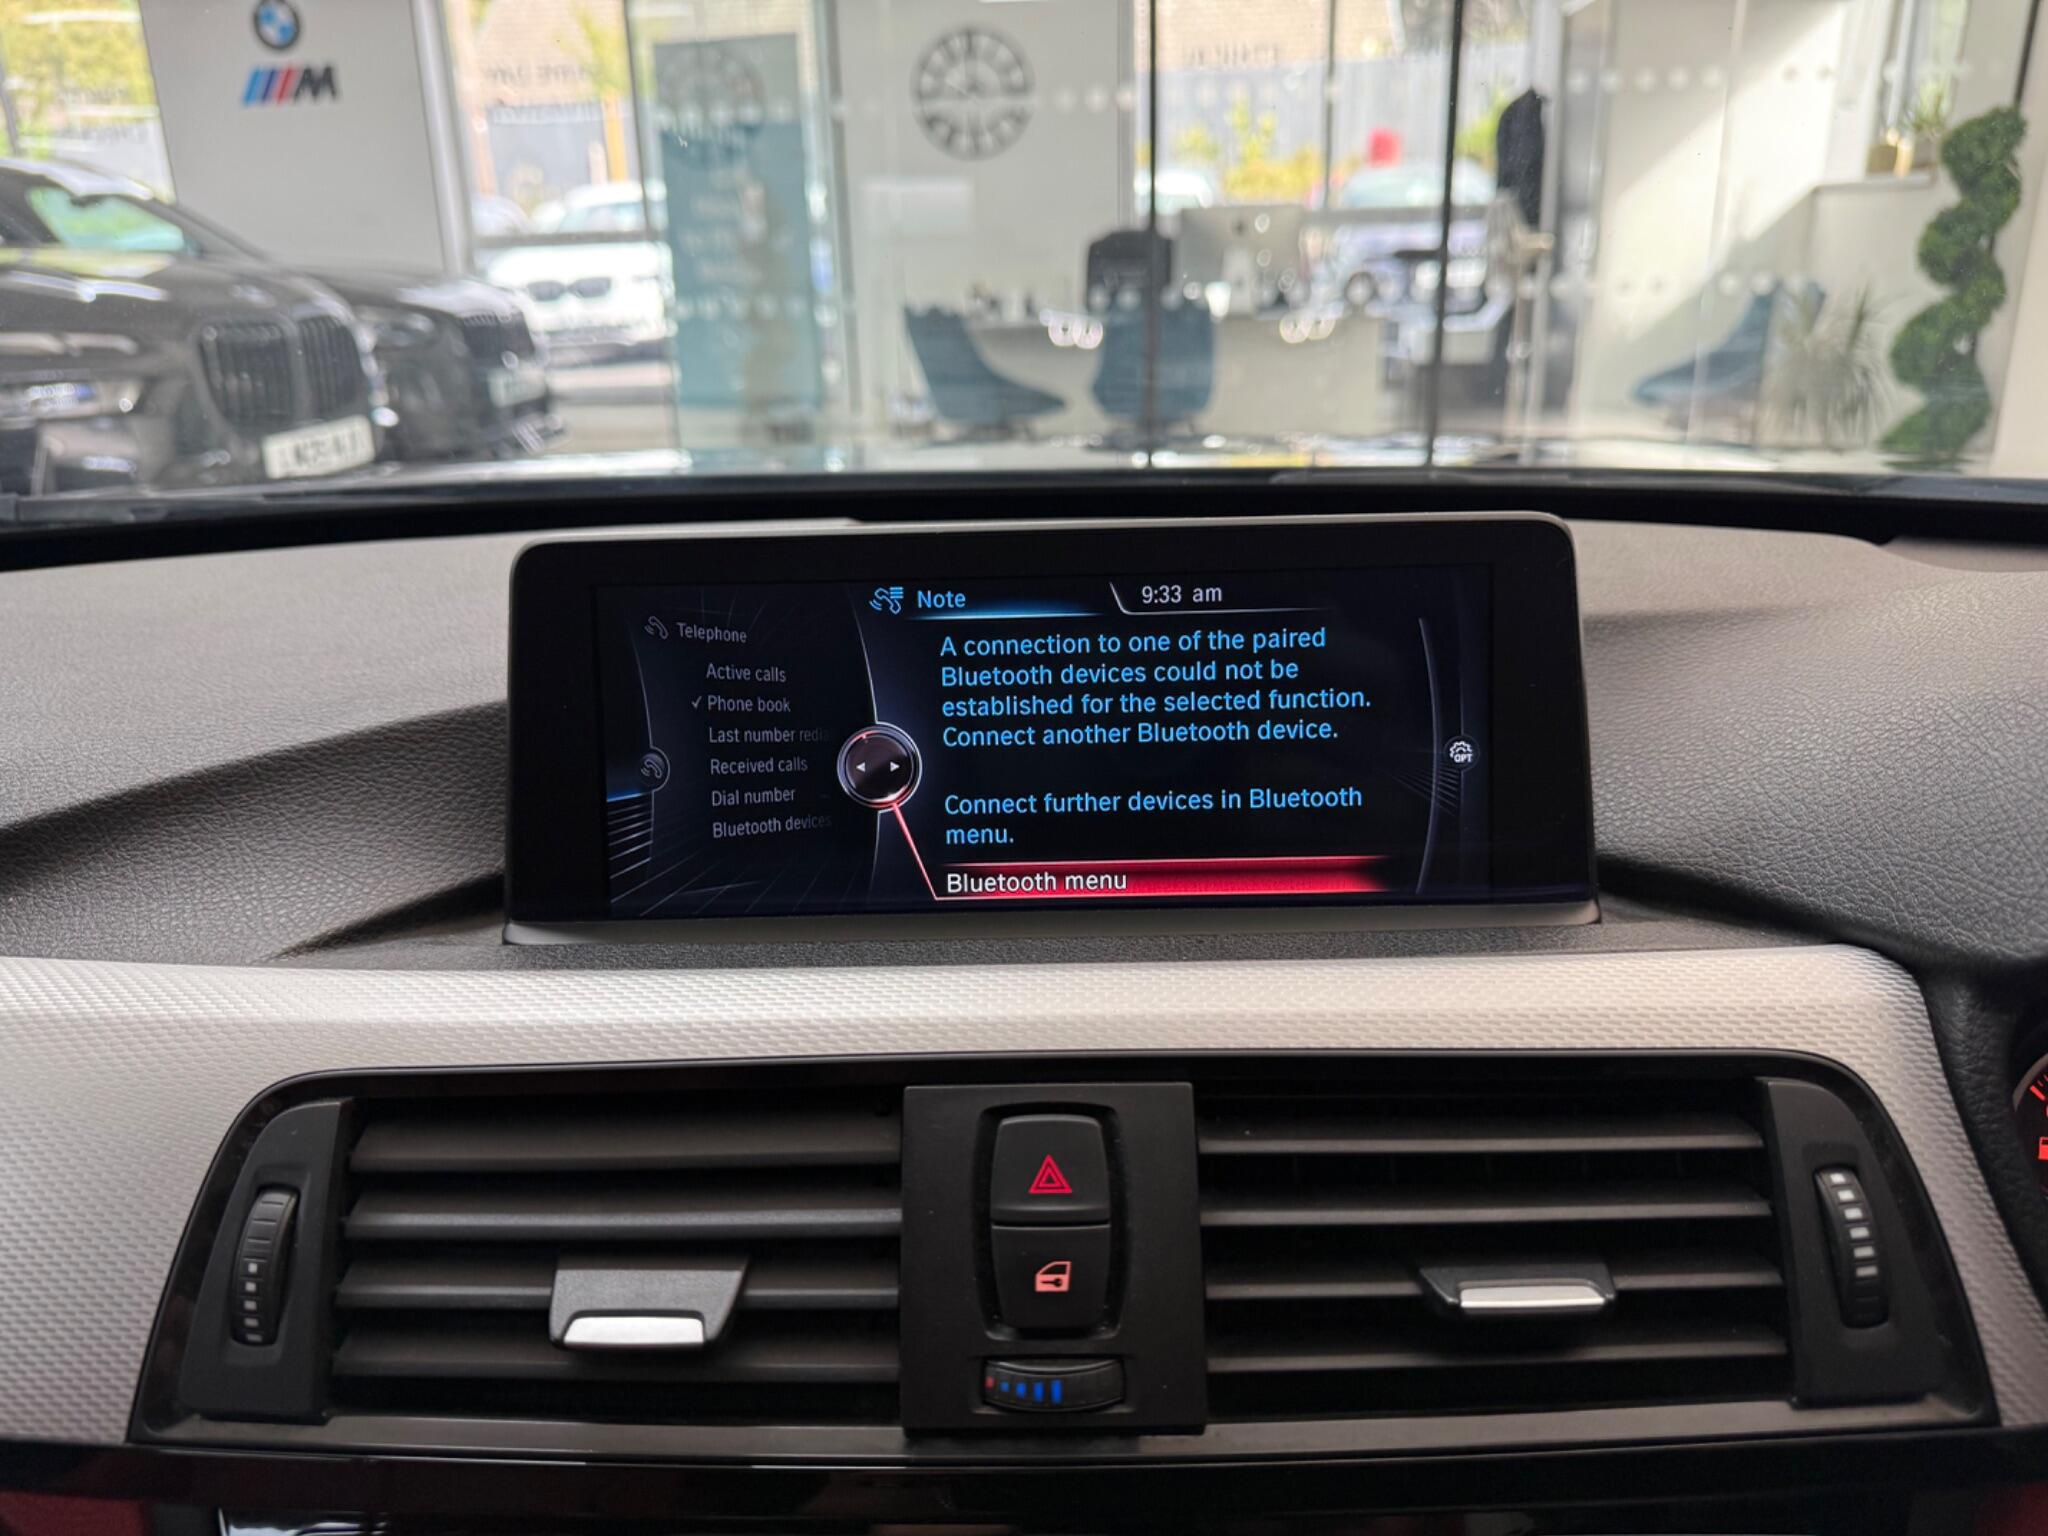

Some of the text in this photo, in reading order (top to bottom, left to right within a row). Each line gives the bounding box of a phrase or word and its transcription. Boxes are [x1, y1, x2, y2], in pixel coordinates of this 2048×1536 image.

[918, 591, 965, 608] Note
[1142, 585, 1221, 603] 9:33 am
[677, 622, 747, 643] Telephone
[940, 627, 1326, 656] A connection to one of the paired
[707, 663, 786, 682] Active calls
[942, 659, 1298, 686] Bluetooth devices could not be
[708, 695, 790, 712] Phone book
[943, 688, 1370, 717] established for the selected function.
[710, 727, 739, 743] Last
[744, 727, 794, 742] number
[943, 719, 1337, 746] Connect another Bluetooth device.
[711, 757, 808, 774] Received calls
[1453, 753, 1473, 763] OPT
[711, 787, 796, 806] Dial number
[945, 787, 1361, 814] Connect further devices in Bluetooth
[712, 817, 782, 839] Bluetooth
[946, 828, 1013, 844] menu.
[947, 872, 1127, 893] Bluetooth menu
